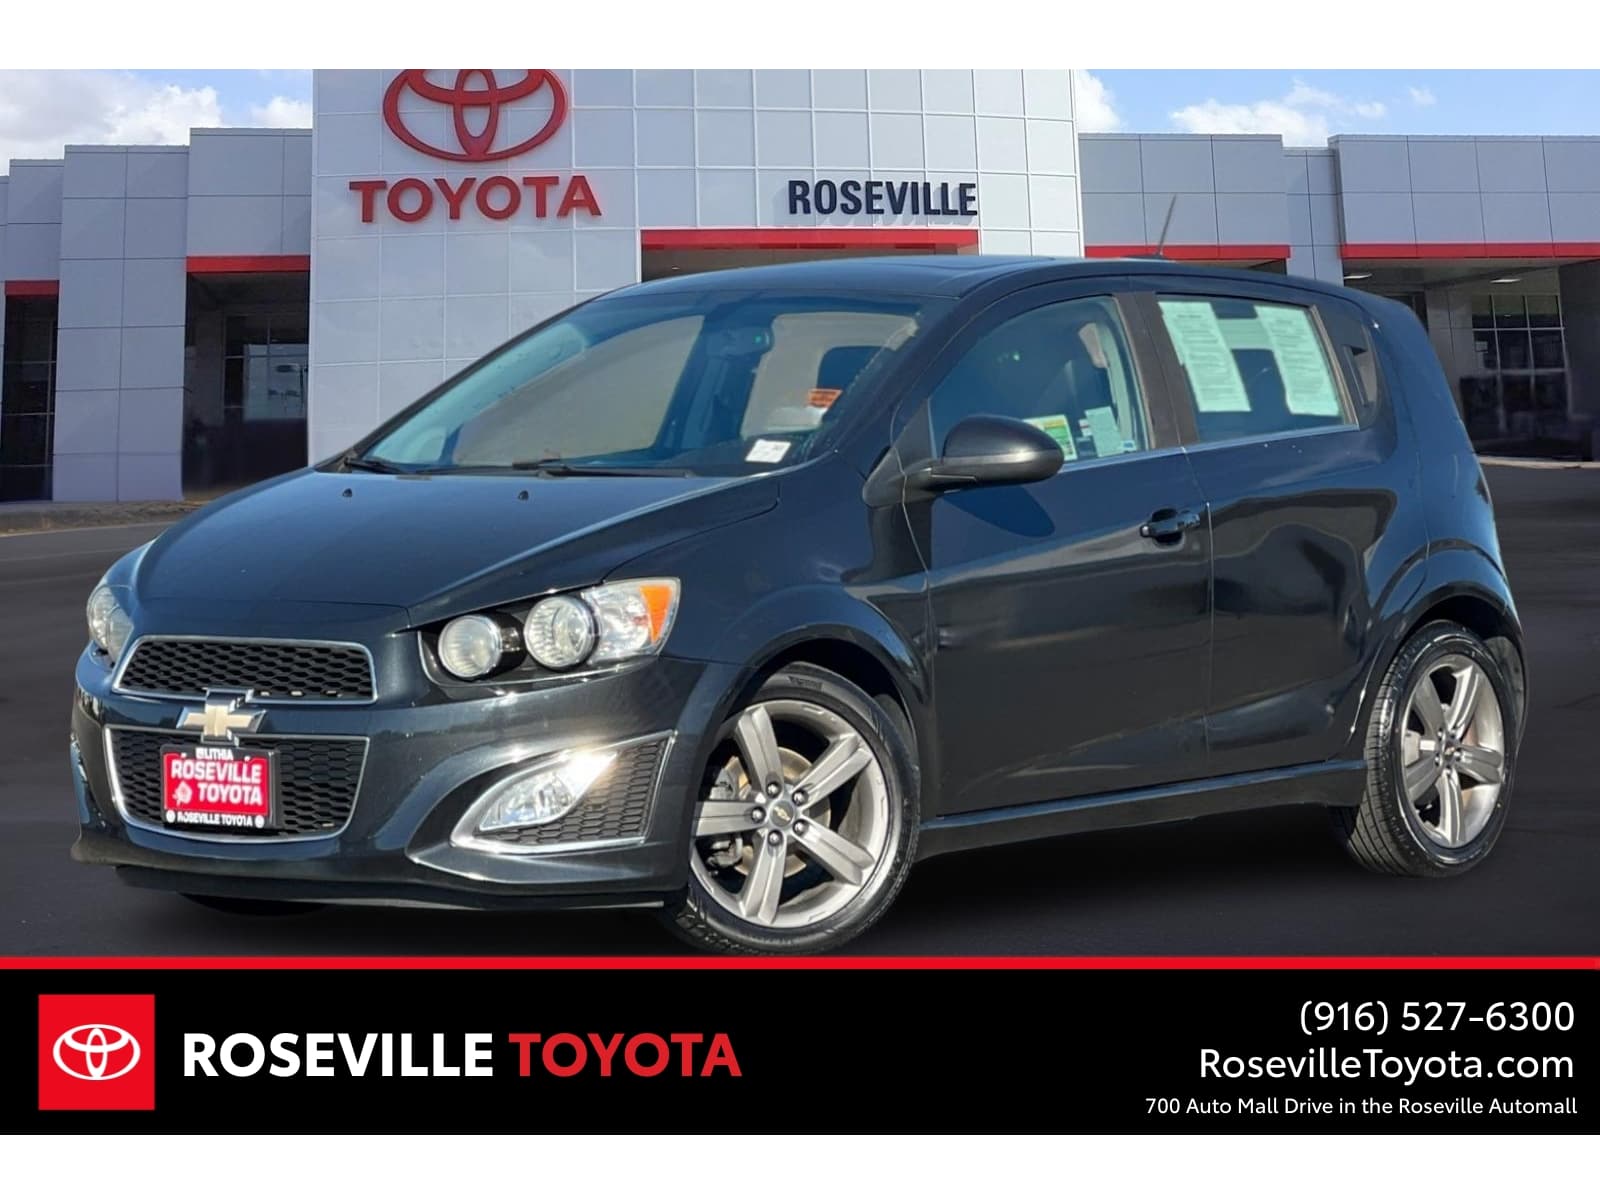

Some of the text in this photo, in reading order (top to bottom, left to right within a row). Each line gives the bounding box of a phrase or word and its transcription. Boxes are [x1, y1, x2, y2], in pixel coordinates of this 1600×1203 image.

[349, 175, 602, 223] TOYOTA
[788, 179, 978, 216] ROSEVILLE
[171, 759, 263, 784] ROSEVILLE
[197, 782, 263, 806] TOYOTA
[177, 811, 254, 827] ROSEVILLE TOYOTA
